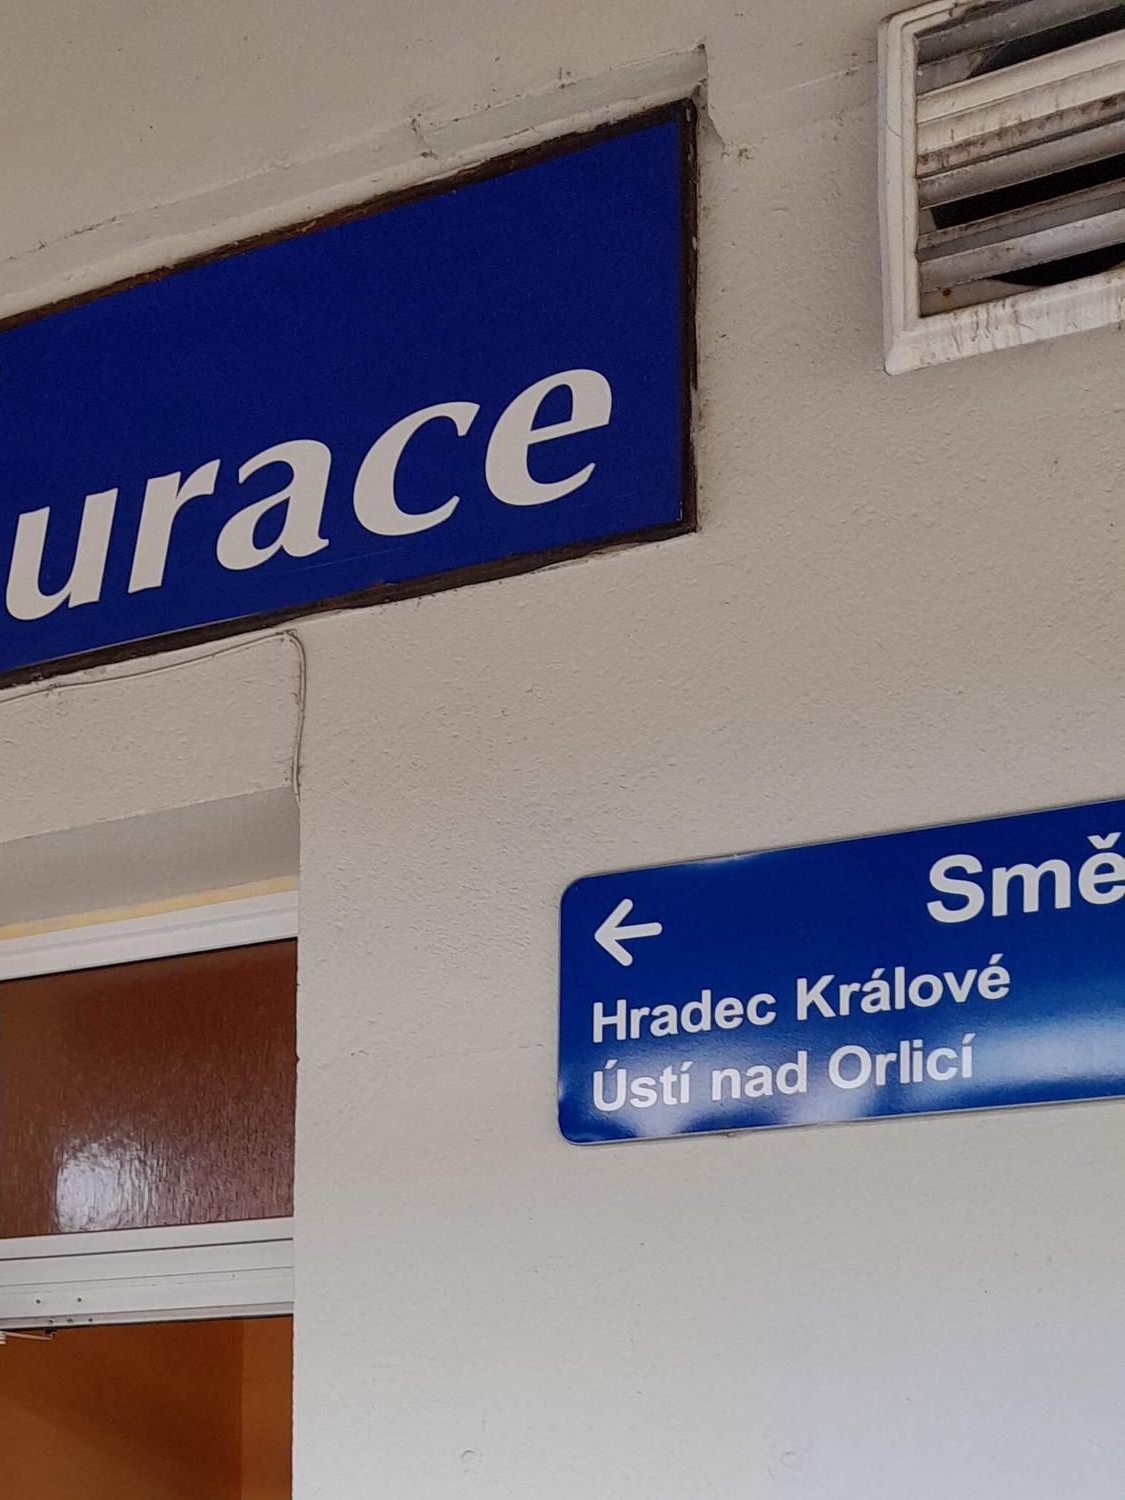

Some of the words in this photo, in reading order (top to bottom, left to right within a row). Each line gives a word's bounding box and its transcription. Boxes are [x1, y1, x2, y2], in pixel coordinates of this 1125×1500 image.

[926, 831, 1125, 924] Smě
[592, 989, 777, 1043] Hradec
[796, 953, 1011, 1021] Králové
[592, 1059, 692, 1112] Ústí
[711, 1050, 809, 1102] nad
[828, 1033, 977, 1090] Orlicí
